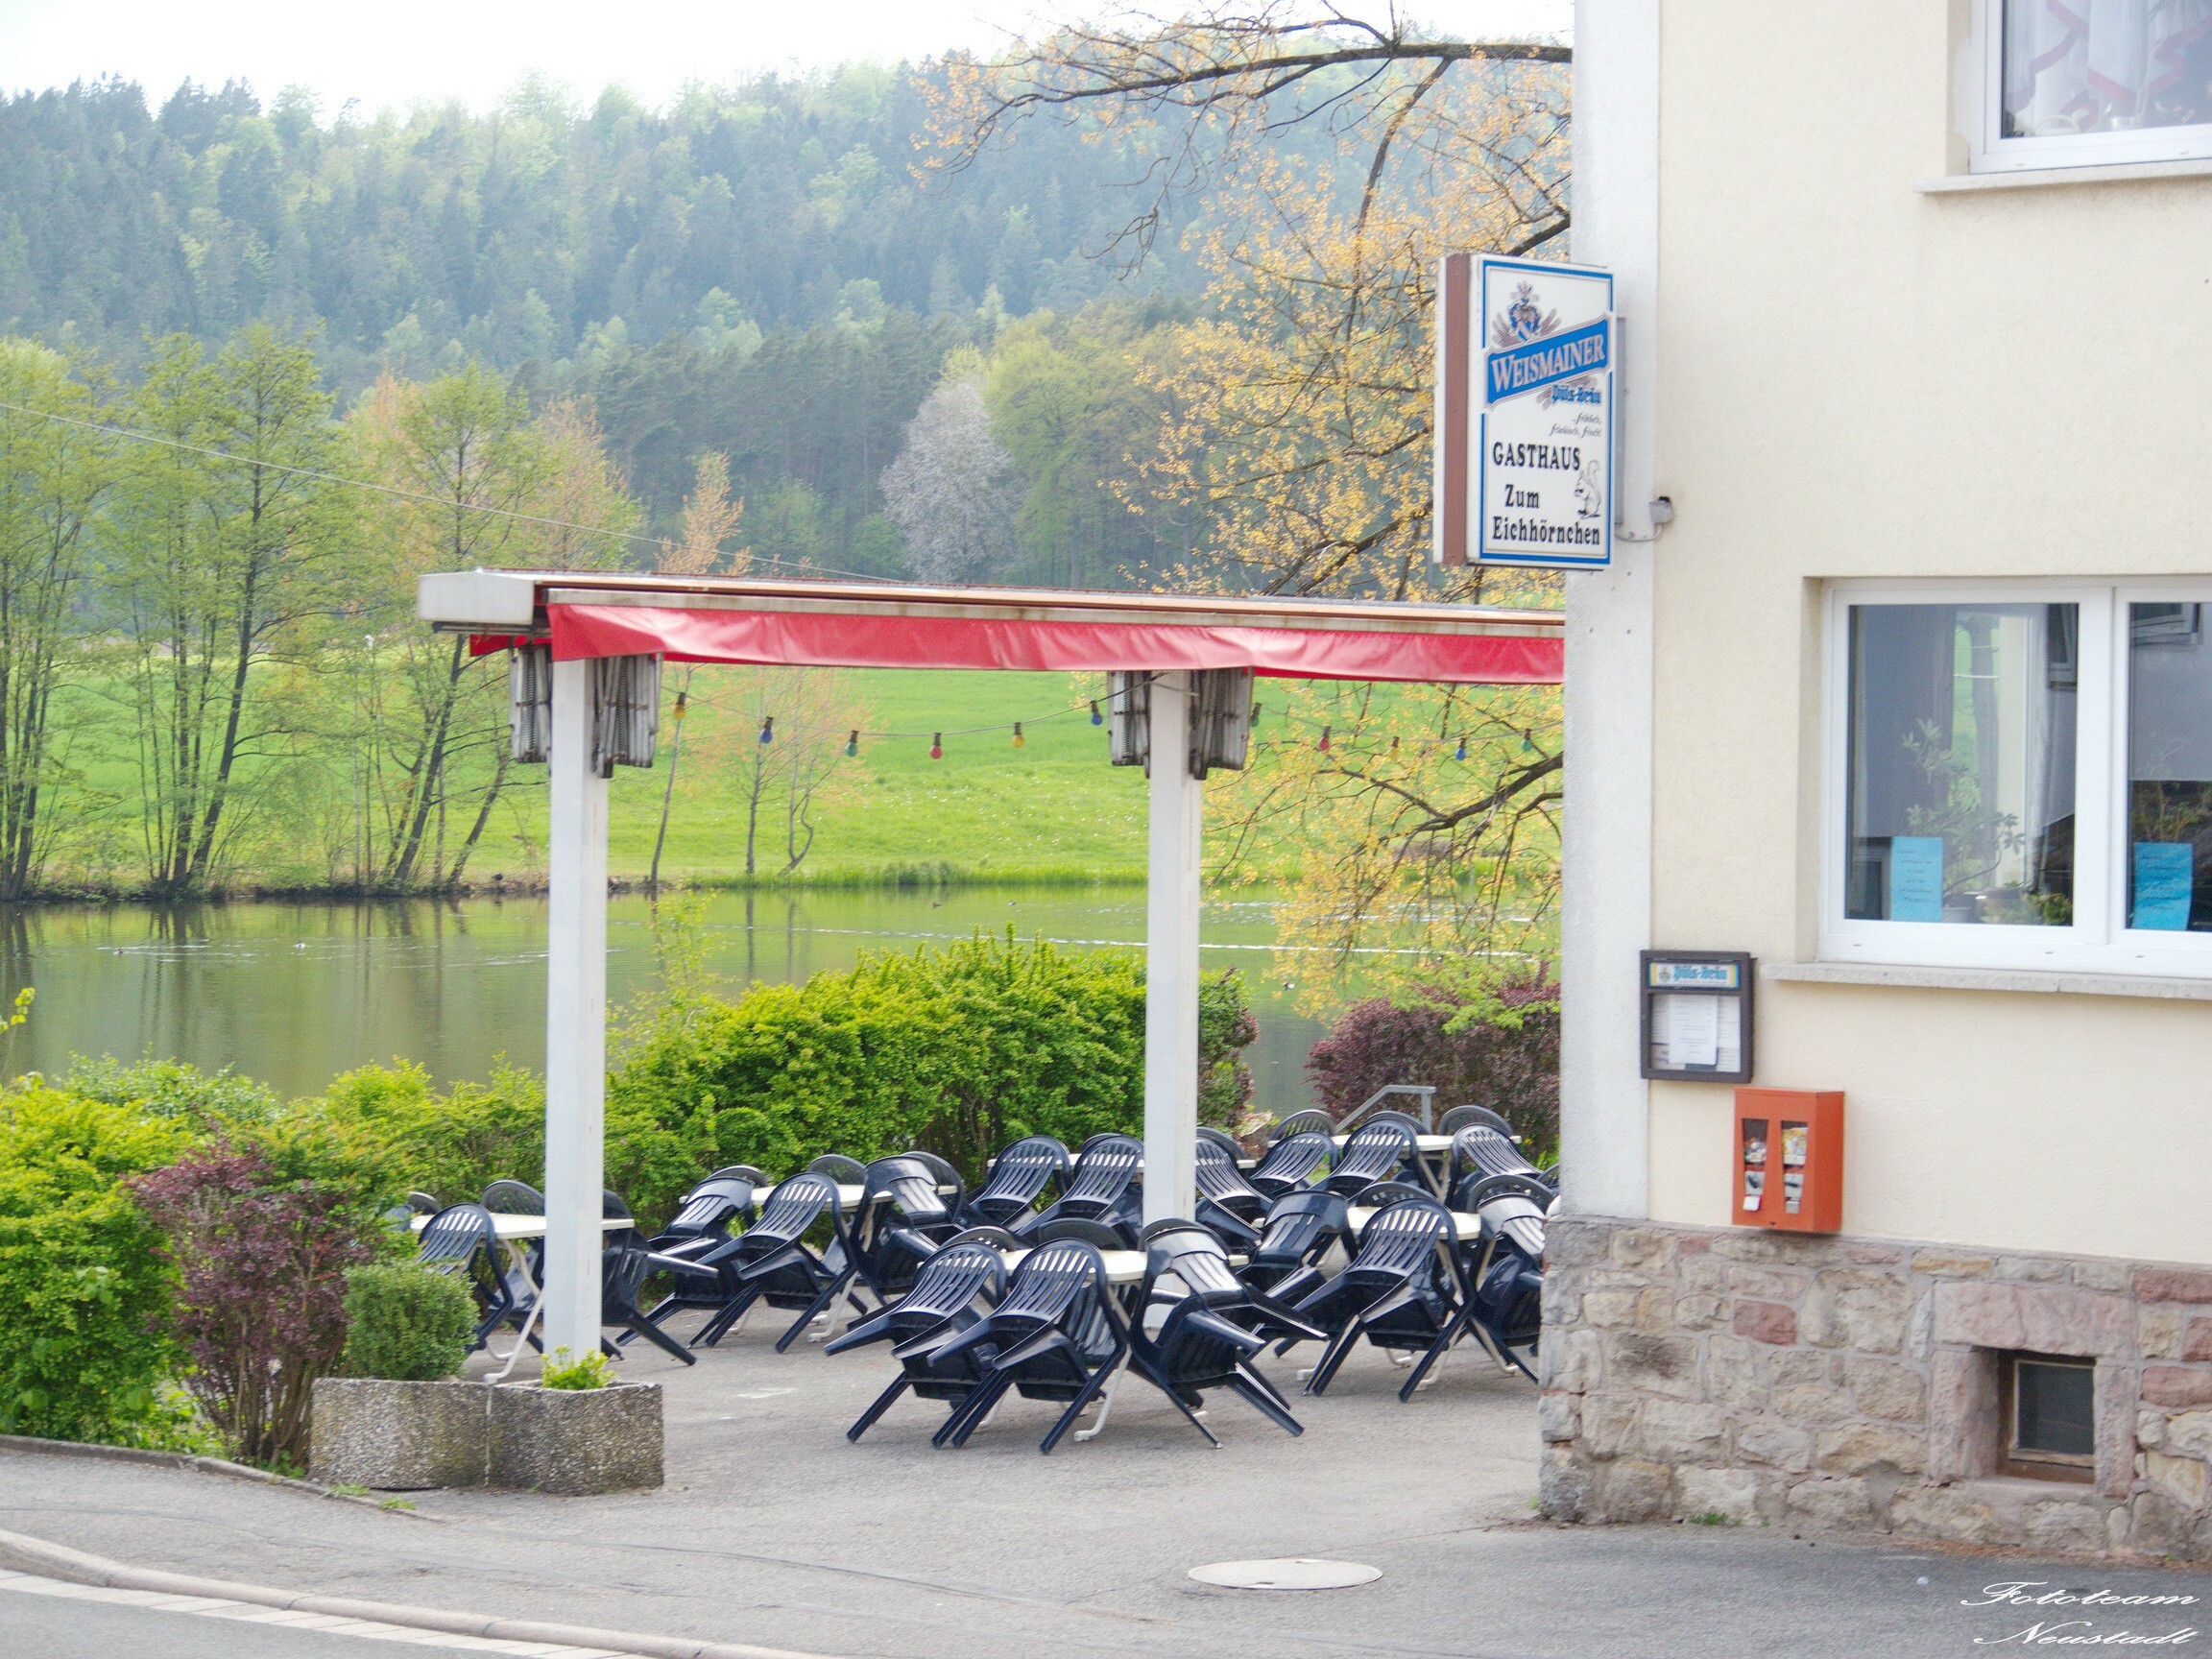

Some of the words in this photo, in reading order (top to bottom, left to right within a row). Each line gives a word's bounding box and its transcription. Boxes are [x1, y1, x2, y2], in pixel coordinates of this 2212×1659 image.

[1490, 333, 1606, 394] WEISMAINER
[1493, 442, 1580, 470] GASTHAUS
[1504, 483, 1540, 509] Zum
[1492, 516, 1600, 545] Eichhörnchen
